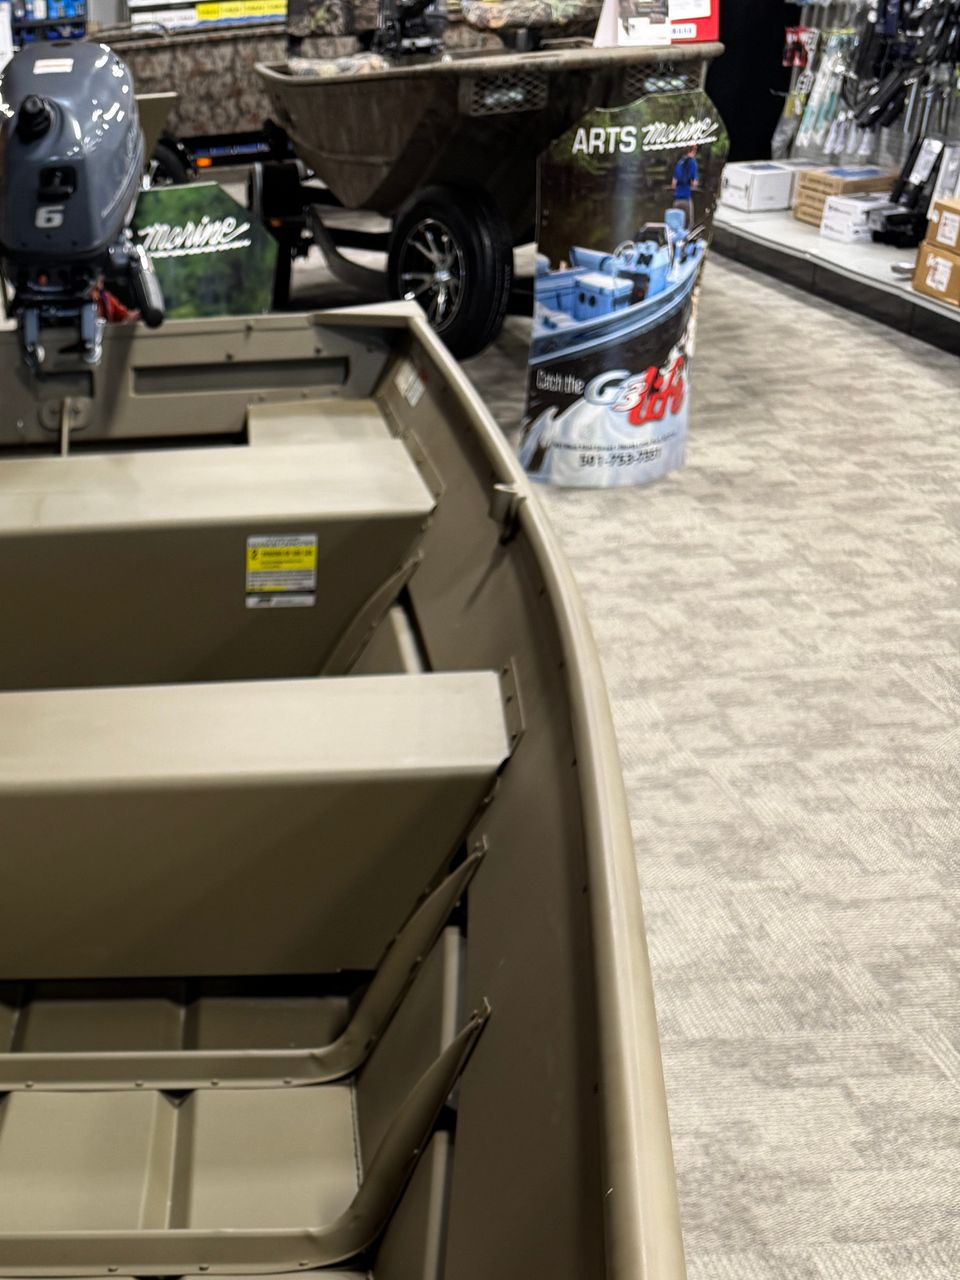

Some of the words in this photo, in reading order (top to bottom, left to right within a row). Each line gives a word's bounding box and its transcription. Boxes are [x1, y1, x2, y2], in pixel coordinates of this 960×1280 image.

[572, 125, 637, 154] ARTS
[641, 117, 718, 149] marine
[34, 205, 65, 228] 6
[138, 215, 251, 254] marine
